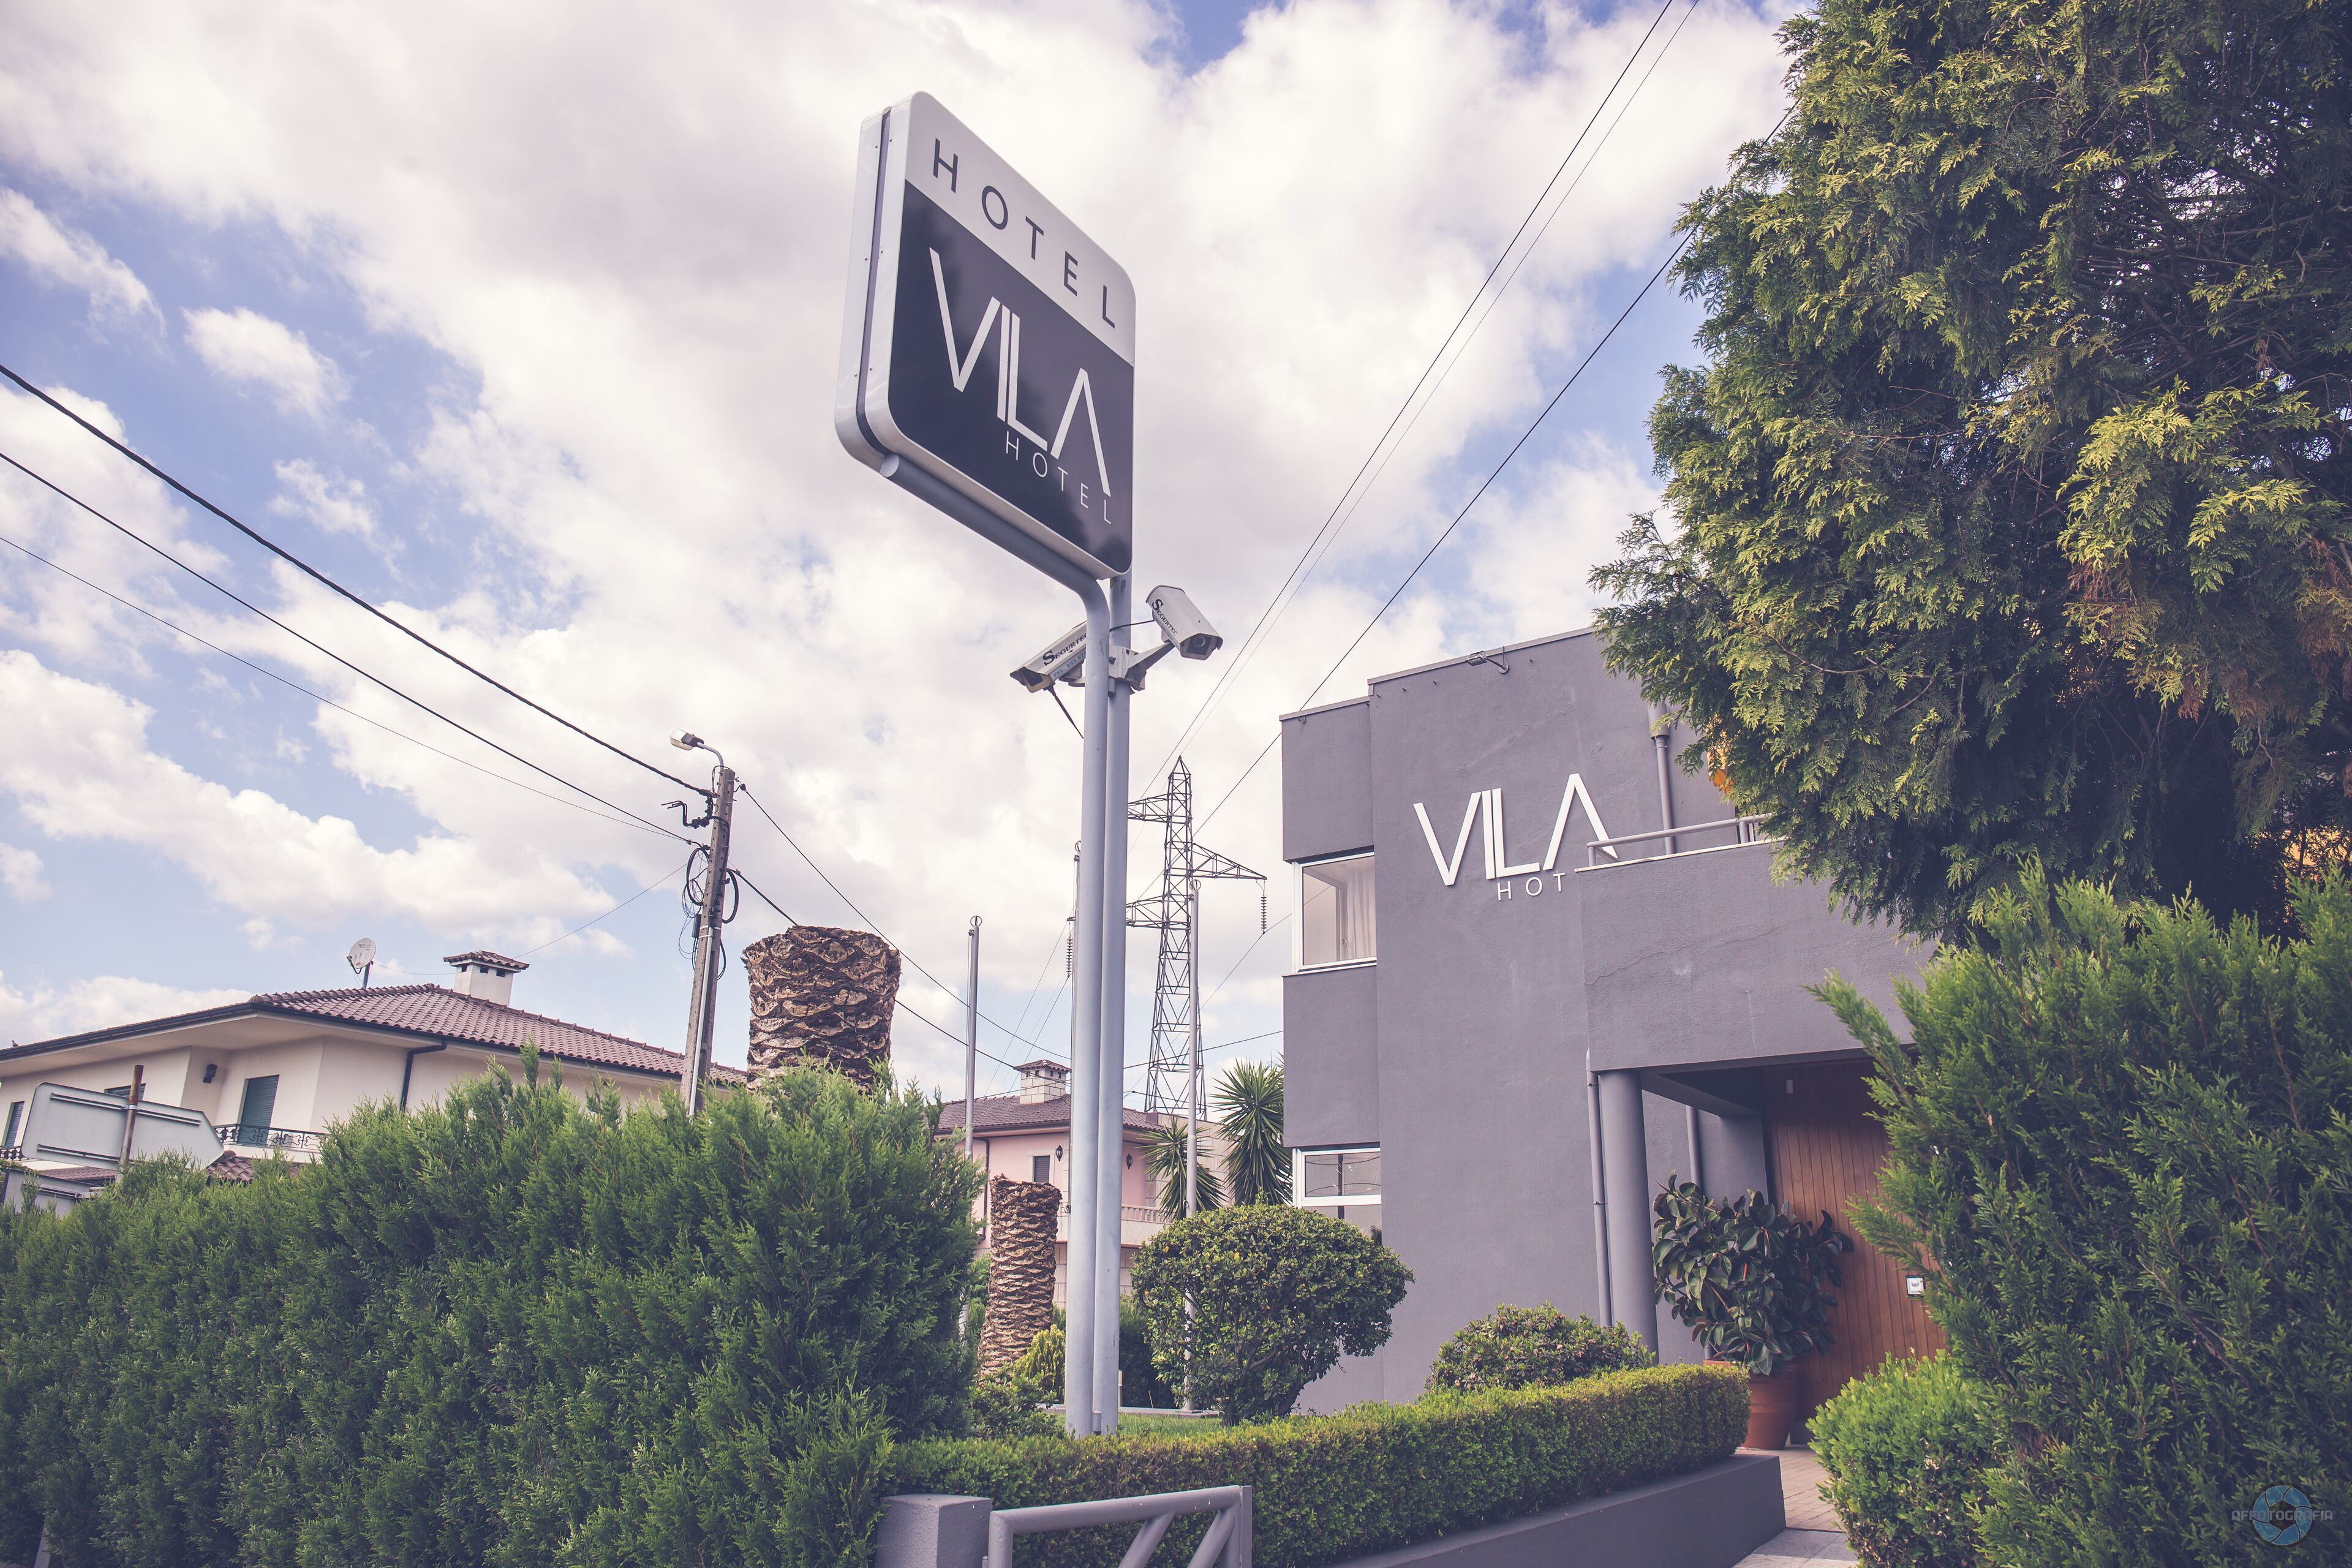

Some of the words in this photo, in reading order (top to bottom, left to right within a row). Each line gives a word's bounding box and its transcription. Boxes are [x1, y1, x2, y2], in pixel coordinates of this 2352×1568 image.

[932, 138, 1115, 329] HOTEL
[929, 247, 1111, 497] VILA
[1005, 431, 1112, 524] HOTEL
[1152, 598, 1178, 636] SEGURTEC
[1413, 773, 1619, 886] VILA
[1497, 872, 1566, 901] HOT
